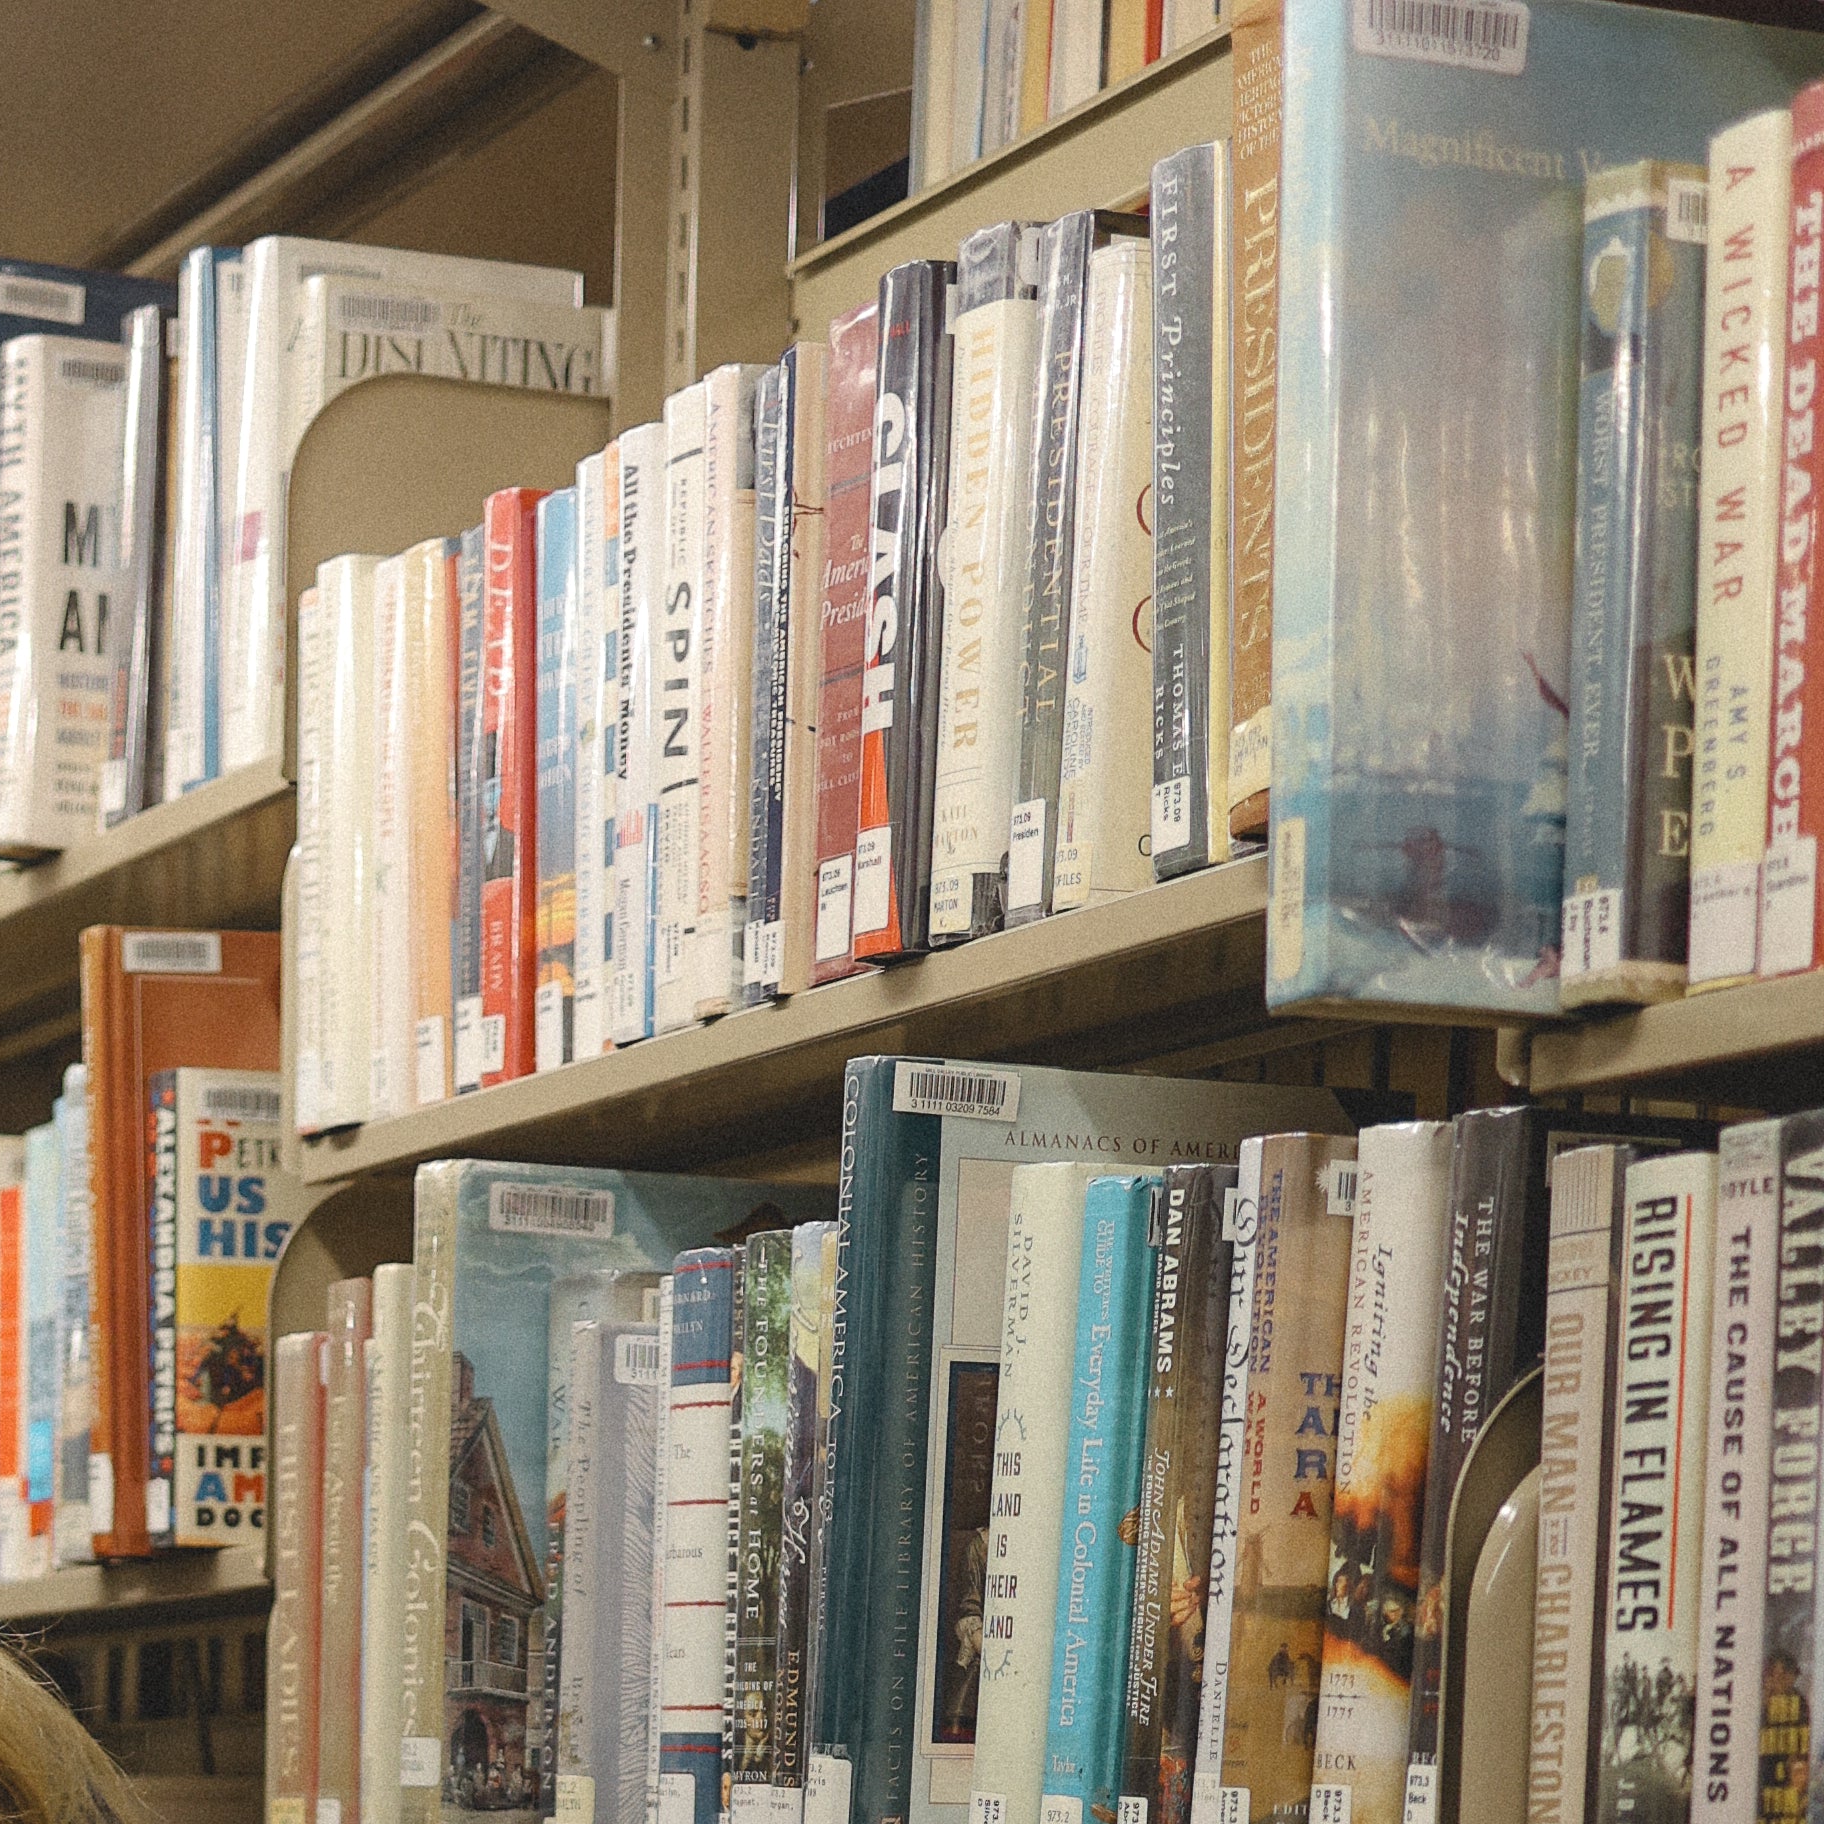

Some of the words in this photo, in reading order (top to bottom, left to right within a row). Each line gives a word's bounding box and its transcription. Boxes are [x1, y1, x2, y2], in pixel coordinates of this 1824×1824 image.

[1726, 167, 1758, 191] A
[1161, 175, 1179, 295] FIRST
[1788, 190, 1818, 369] THE
[1717, 224, 1755, 453] WICKED
[759, 419, 775, 499] First
[963, 327, 996, 528] HIDDEN
[1157, 315, 1183, 505] Principles
[1239, 187, 1277, 650] PRESIDENTS
[1589, 389, 1614, 489] WORST.
[622, 499, 639, 533] the
[623, 464, 640, 498] All
[702, 400, 721, 538] AMERICAN
[1782, 387, 1816, 561] DEAD
[758, 513, 779, 603] Dads
[863, 392, 906, 735] CLASH
[1035, 350, 1075, 723] PRESIDENTIAL
[1713, 488, 1748, 606] WAR
[620, 536, 640, 698] Presidents'
[701, 543, 716, 675] SKETCHES
[1585, 504, 1610, 671] PRESIDENT.
[662, 581, 694, 757] SPIN
[951, 559, 987, 751] POWER
[1170, 644, 1186, 753] THOMAS
[616, 699, 636, 781] Money
[1153, 686, 1166, 760] RICKS
[1582, 684, 1603, 759] EVER.
[1698, 655, 1721, 837] GREENBERG
[1772, 586, 1808, 848] MARCH
[1162, 786, 1172, 821] Ricks
[1172, 782, 1183, 823] 973.09
[1582, 899, 1595, 969] Buchanan
[911, 1098, 918, 1109] 3
[921, 1099, 944, 1111] 1111
[945, 1101, 975, 1113] 03209
[977, 1104, 1001, 1116] 7584
[1003, 1128, 1124, 1151] ALMANACS
[1131, 1137, 1163, 1158] OF
[152, 1107, 178, 1319] ALEXANDRA
[1165, 1187, 1187, 1248] DAN
[1227, 1197, 1259, 1303] Our
[1350, 1170, 1376, 1313] AMERICAN
[1476, 1197, 1495, 1258] THE
[1001, 1213, 1024, 1379] SILVERMAN
[1156, 1254, 1180, 1374] ABRAMS
[1364, 1244, 1395, 1376] Igniting
[1468, 1268, 1491, 1325] WAR
[1625, 1195, 1678, 1362] RISING
[1728, 1223, 1753, 1310] THE
[1438, 1210, 1472, 1436] Independence
[1545, 1313, 1588, 1395] OUR
[152, 1326, 176, 1455] PETRI'S
[406, 1301, 449, 1504] Thirteen
[1078, 1323, 1113, 1433] Everyday
[1336, 1324, 1364, 1497] REVOLUTION
[1361, 1386, 1379, 1421] the
[1461, 1335, 1485, 1445] BEFORE
[1623, 1381, 1669, 1423] IN
[1721, 1323, 1751, 1452] CAUSE
[990, 1492, 1023, 1518] LAND
[994, 1452, 1023, 1476] THIS
[1077, 1493, 1097, 1514] in
[1080, 1438, 1105, 1487] Life
[1150, 1449, 1170, 1511] JOHN
[1208, 1328, 1251, 1603] Declaration
[1540, 1413, 1581, 1512] MAN
[1719, 1469, 1743, 1521] OF
[983, 1575, 1019, 1599] THEIR
[1069, 1521, 1096, 1623] Colonial
[1144, 1516, 1167, 1598] ADAMS
[1615, 1449, 1665, 1633] FLAMES
[1715, 1539, 1741, 1612] ALL
[399, 1520, 440, 1740] Colonies
[983, 1617, 1014, 1640] LAND
[1058, 1629, 1085, 1727] America
[1142, 1602, 1162, 1669] UNDER
[1136, 1673, 1157, 1727] FIRE
[1208, 1660, 1228, 1761] DANIELLE
[1528, 1564, 1572, 1824] CHARLESTON
[1707, 1626, 1737, 1804] NATIONS
[1042, 1808, 1072, 1824] 973.2
[1228, 1789, 1239, 1824] 973.3
[1332, 1788, 1344, 1824] 973.3
[1404, 1794, 1427, 1807] Beck
